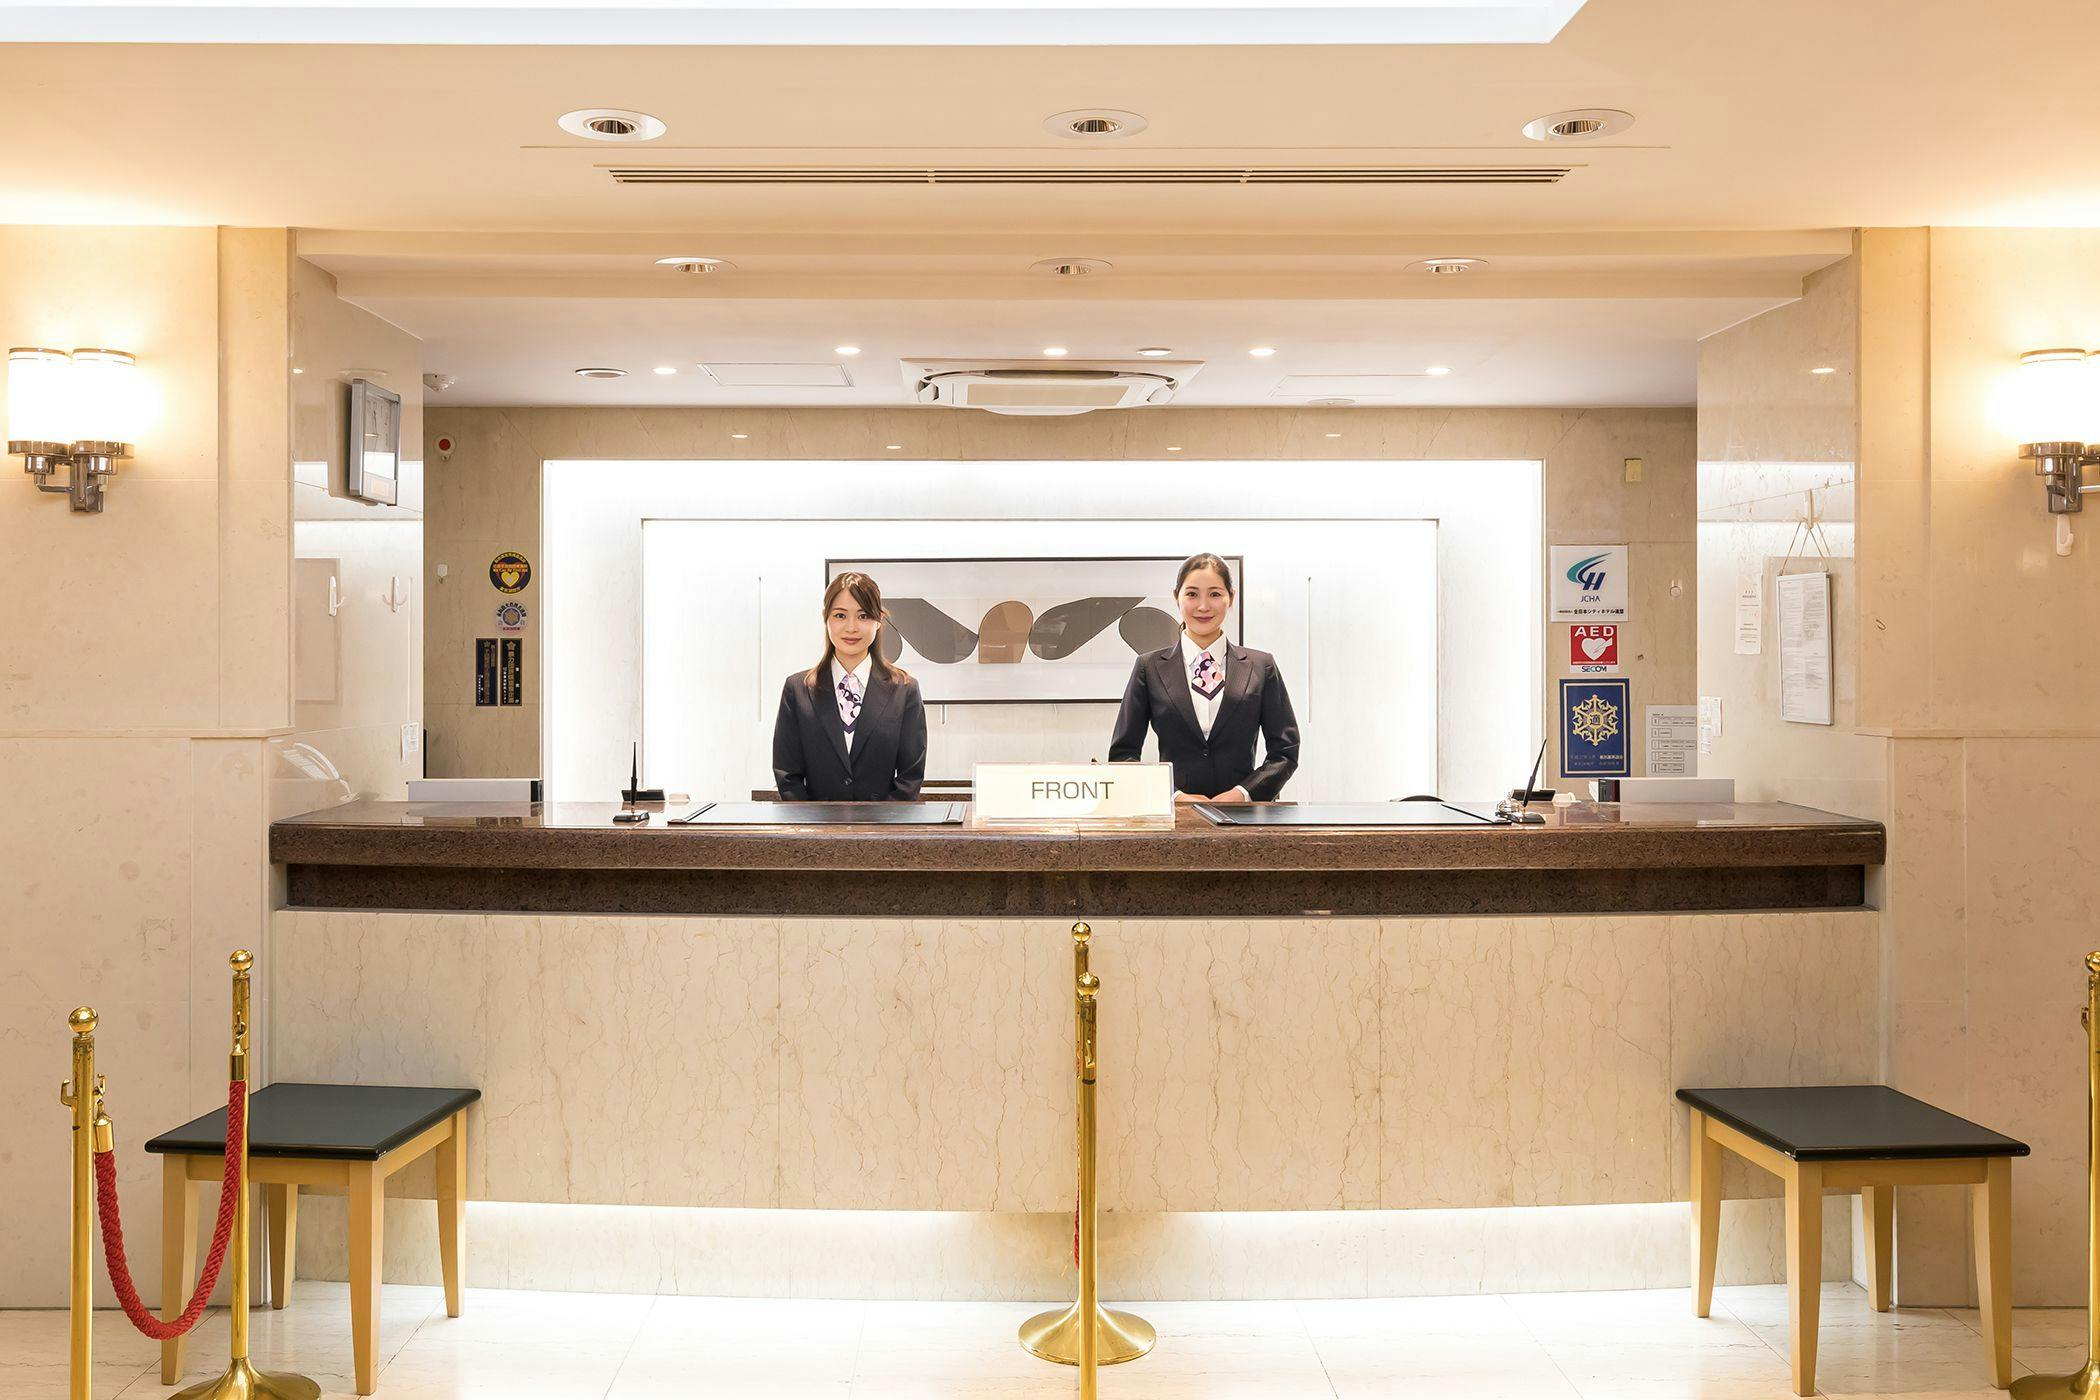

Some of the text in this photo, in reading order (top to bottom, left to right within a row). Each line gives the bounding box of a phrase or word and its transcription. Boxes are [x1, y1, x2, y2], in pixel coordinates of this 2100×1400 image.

[1575, 626, 1614, 637] AED
[1581, 665, 1607, 673] SECOM
[1031, 781, 1114, 800] FRONT
